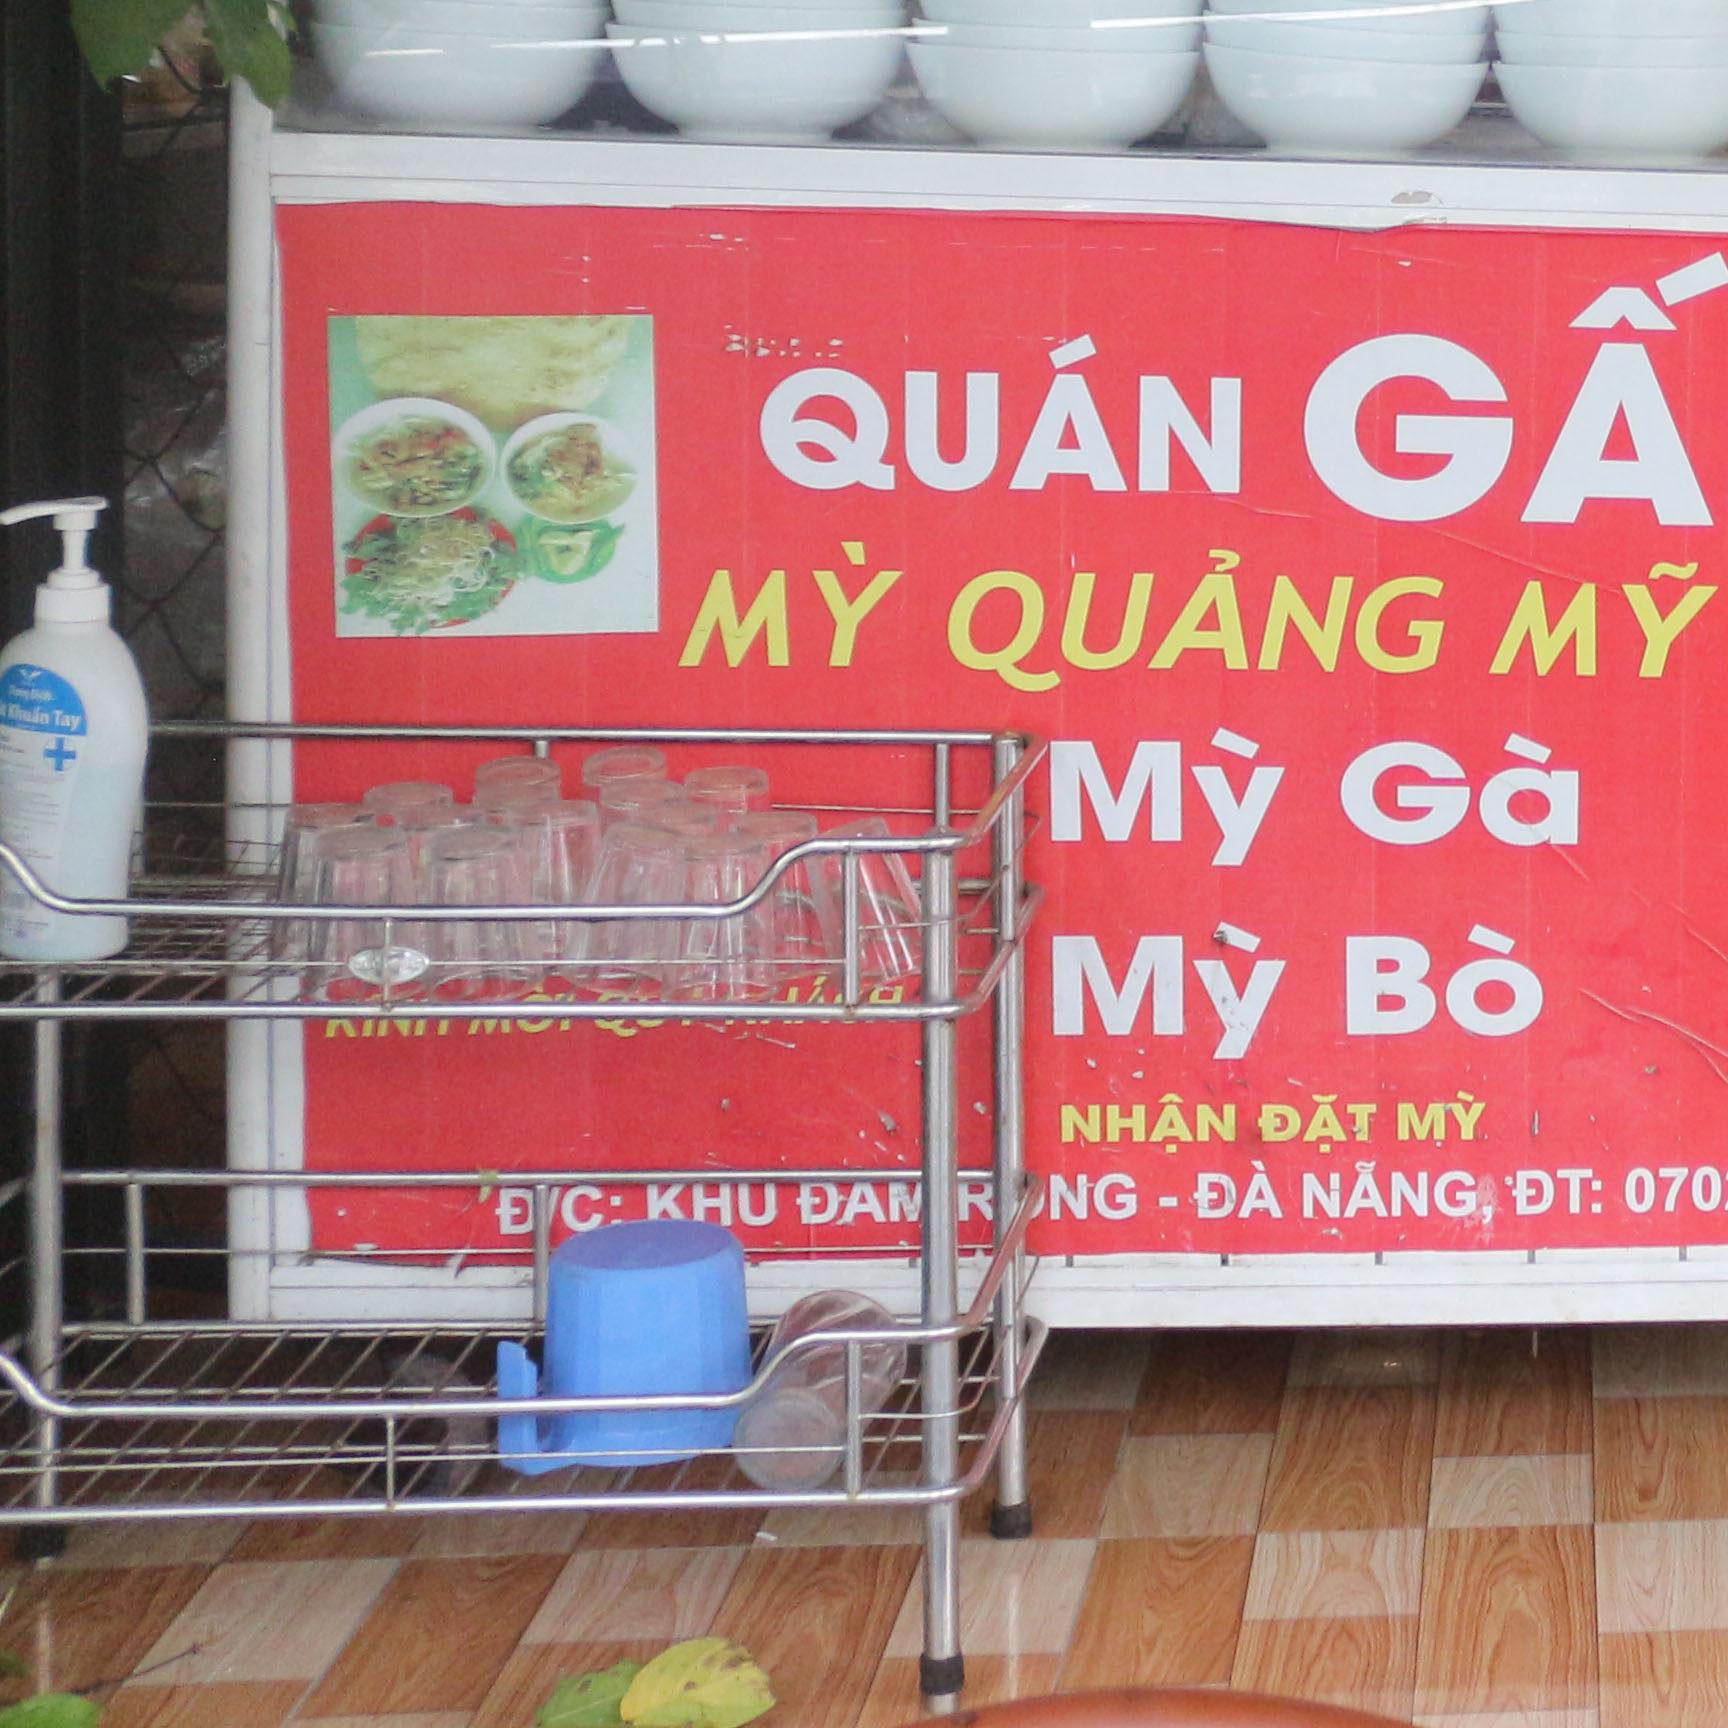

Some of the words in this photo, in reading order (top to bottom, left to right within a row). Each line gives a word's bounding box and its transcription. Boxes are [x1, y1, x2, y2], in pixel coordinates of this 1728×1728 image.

[759, 334, 1242, 494] QUÁN
[679, 541, 903, 669] MỲ
[947, 549, 1446, 692] QUẢNG
[1489, 562, 1718, 678] MỸ
[53, 710, 81, 731] Tay
[1050, 727, 1285, 866] Mỳ
[1340, 733, 1580, 848] Gà
[1052, 921, 1287, 1060] Mỳ
[1345, 924, 1544, 1038] Bò
[1061, 1092, 1236, 1154] NHẬN
[1257, 1093, 1376, 1154] ĐẶT
[1397, 1091, 1486, 1141] MỲ
[646, 1183, 778, 1227] KHU
[1194, 1160, 1284, 1220] ĐÀ
[1504, 1168, 1604, 1217] ĐT:
